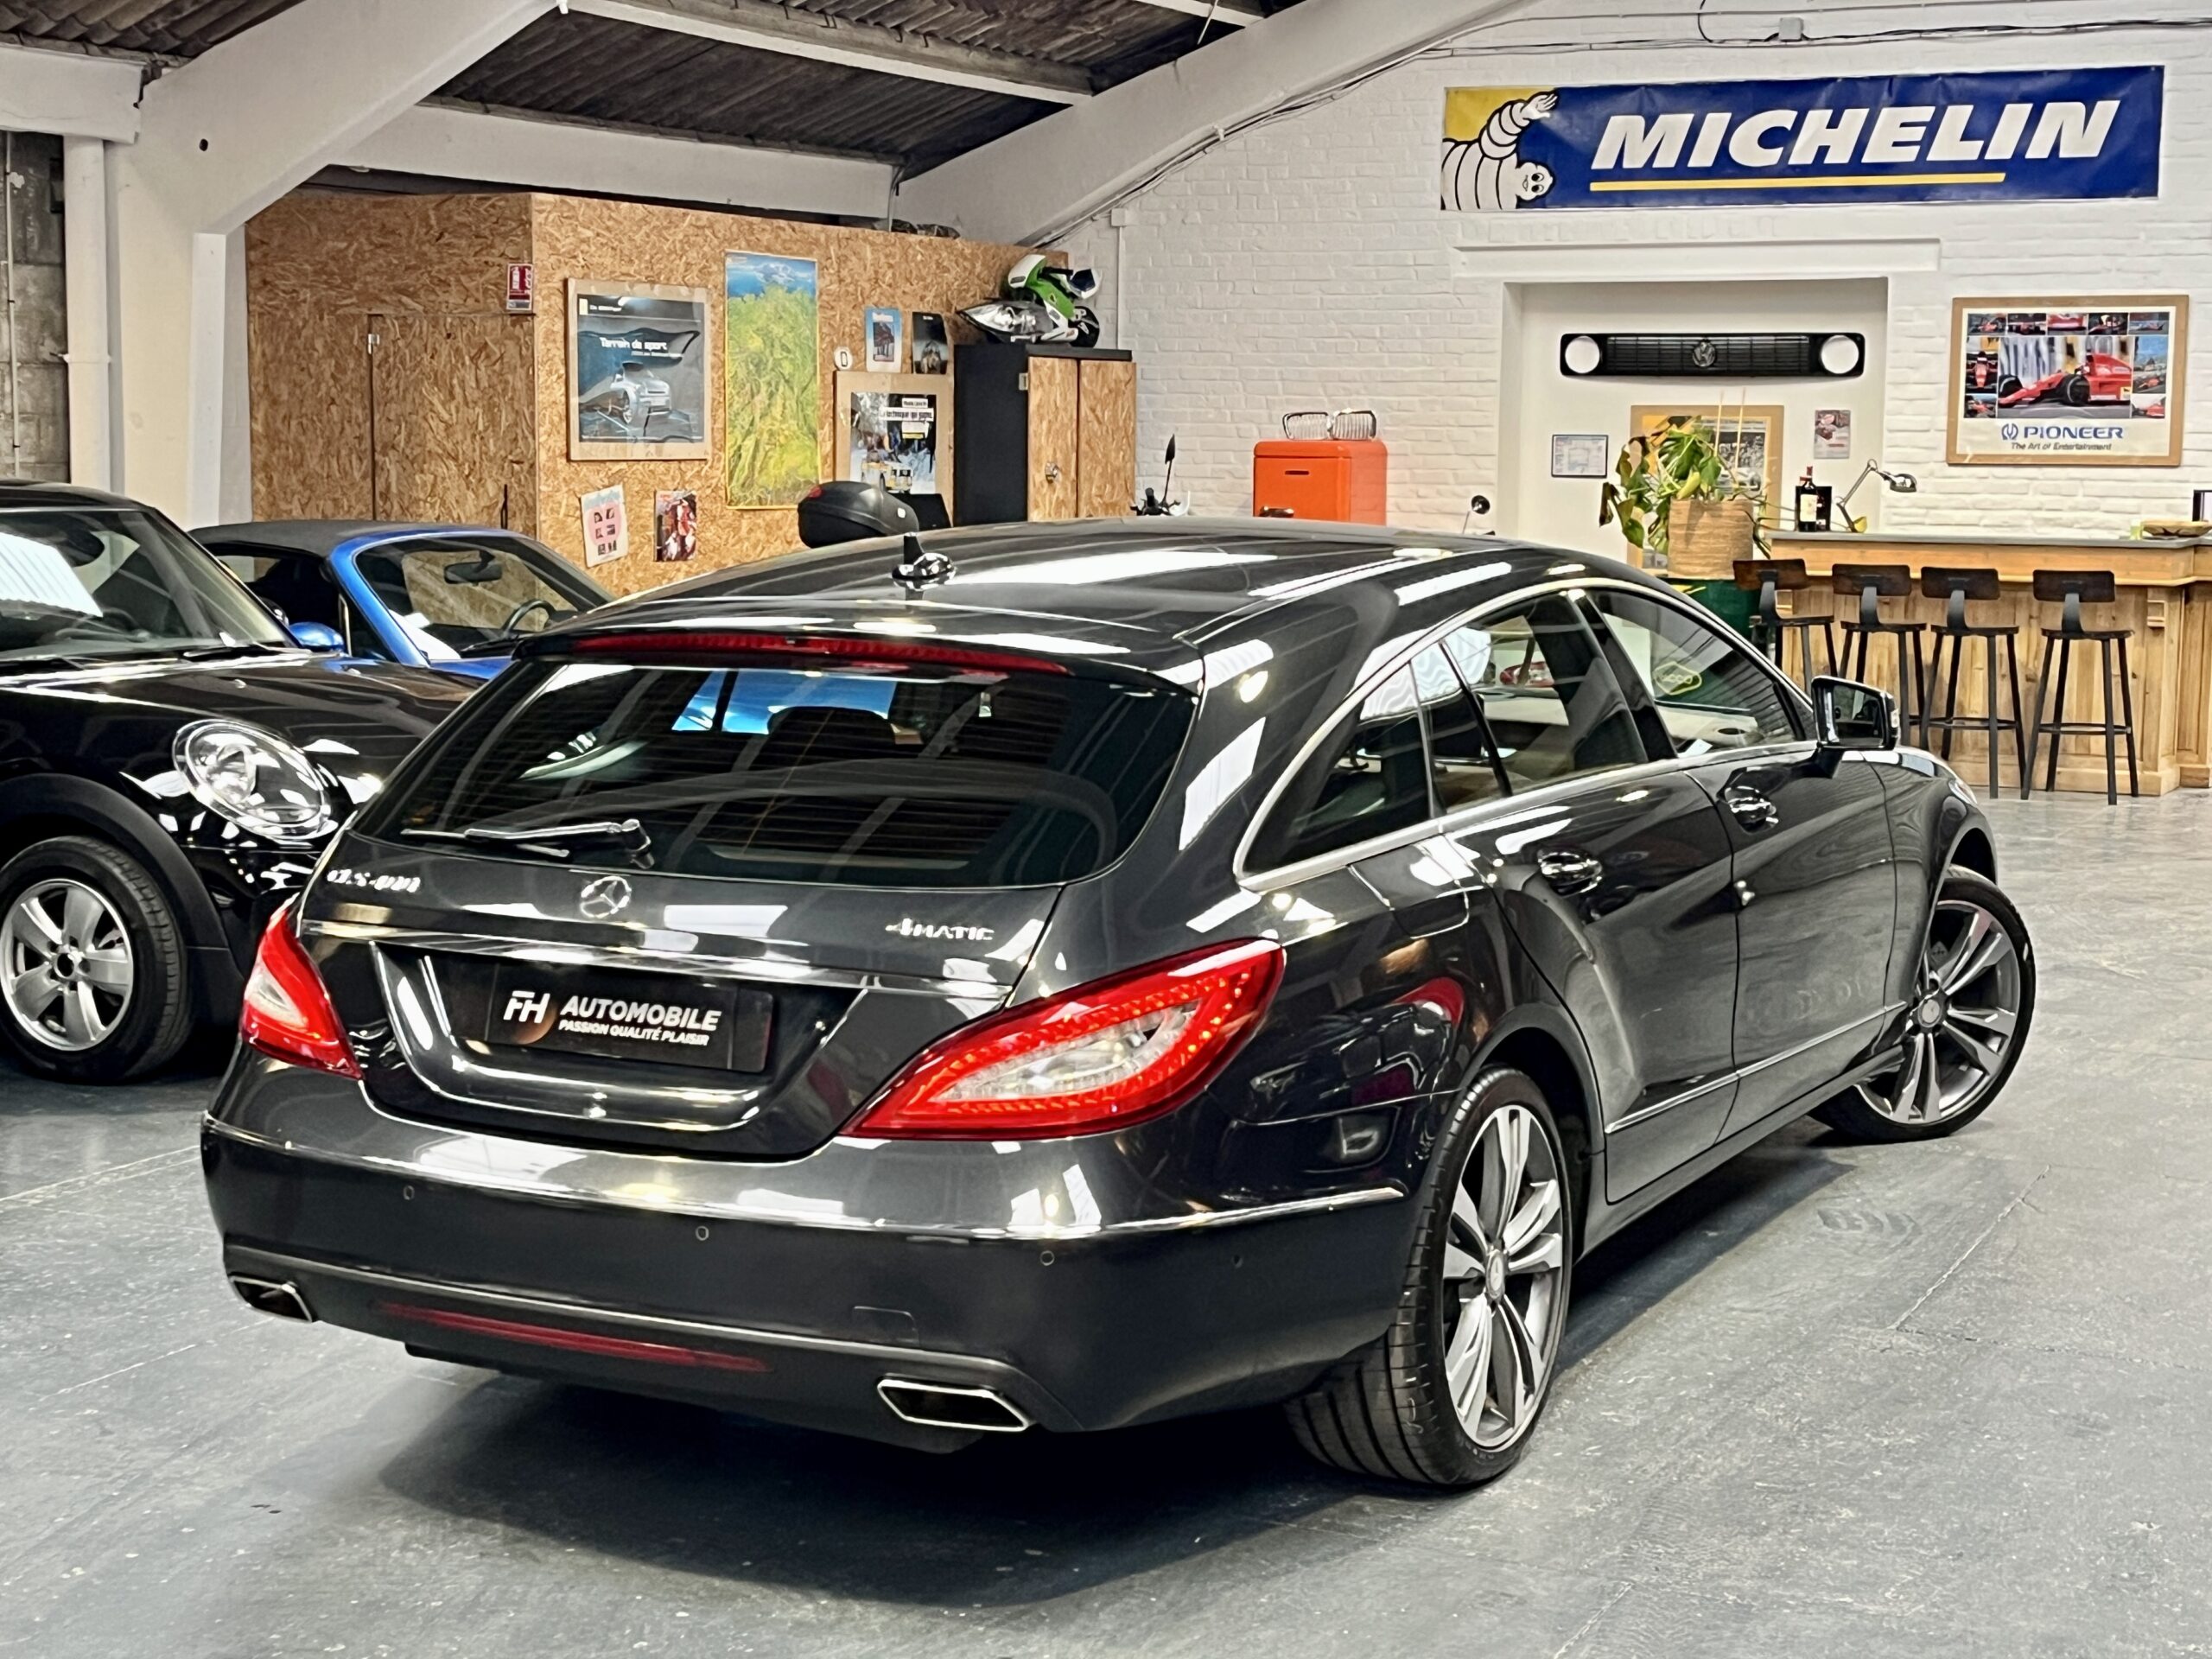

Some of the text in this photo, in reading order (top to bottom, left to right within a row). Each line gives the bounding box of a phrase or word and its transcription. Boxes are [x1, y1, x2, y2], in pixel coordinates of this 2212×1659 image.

[1591, 99, 2121, 170] MICHELIN
[2024, 426, 2124, 439] PIONEER
[2053, 442, 2113, 451] Entertainment
[503, 989, 550, 1024] FH
[560, 995, 722, 1032] AUTOMOBILE
[558, 1019, 710, 1046] PASSION QUALITÉ PLAISIR
